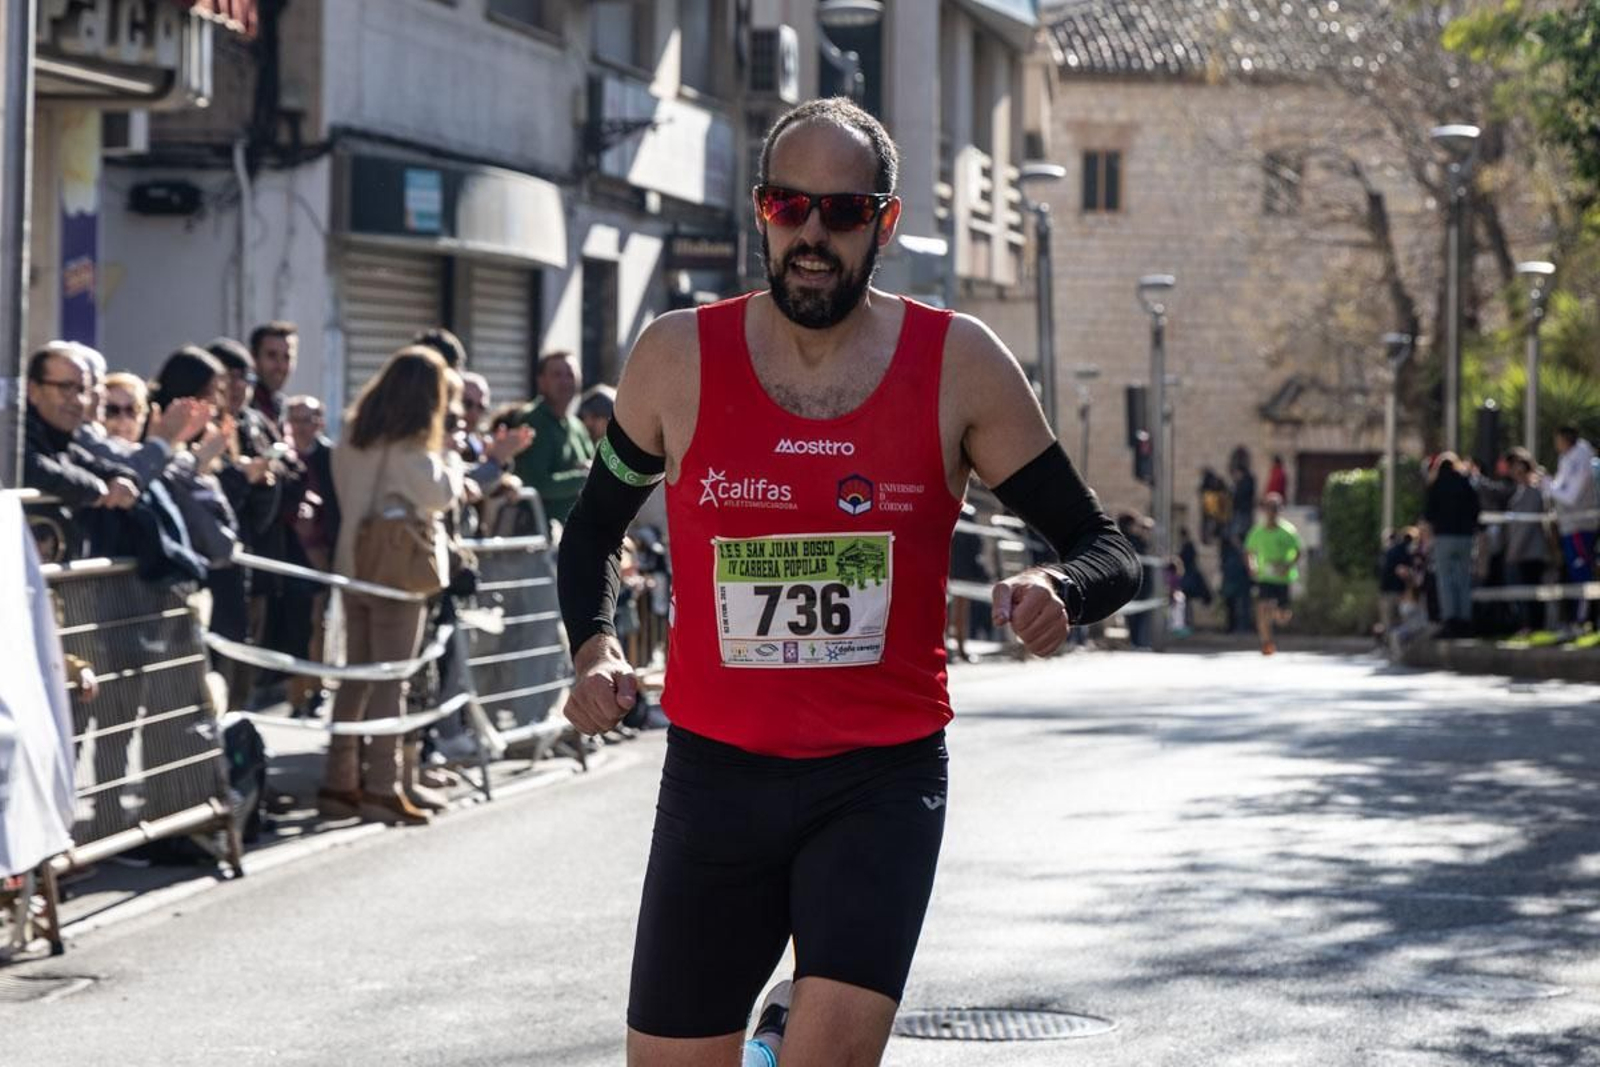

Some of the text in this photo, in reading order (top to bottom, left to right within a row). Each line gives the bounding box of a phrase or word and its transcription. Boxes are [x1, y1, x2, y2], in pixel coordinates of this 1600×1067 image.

[774, 438, 855, 456] Mosttro
[717, 477, 792, 501] califas
[747, 542, 765, 558] SAN
[769, 541, 798, 557] JUAN
[803, 540, 835, 556] BOSCO
[728, 560, 738, 575] IV
[784, 559, 827, 578] POPULAR
[753, 583, 851, 636] 736
